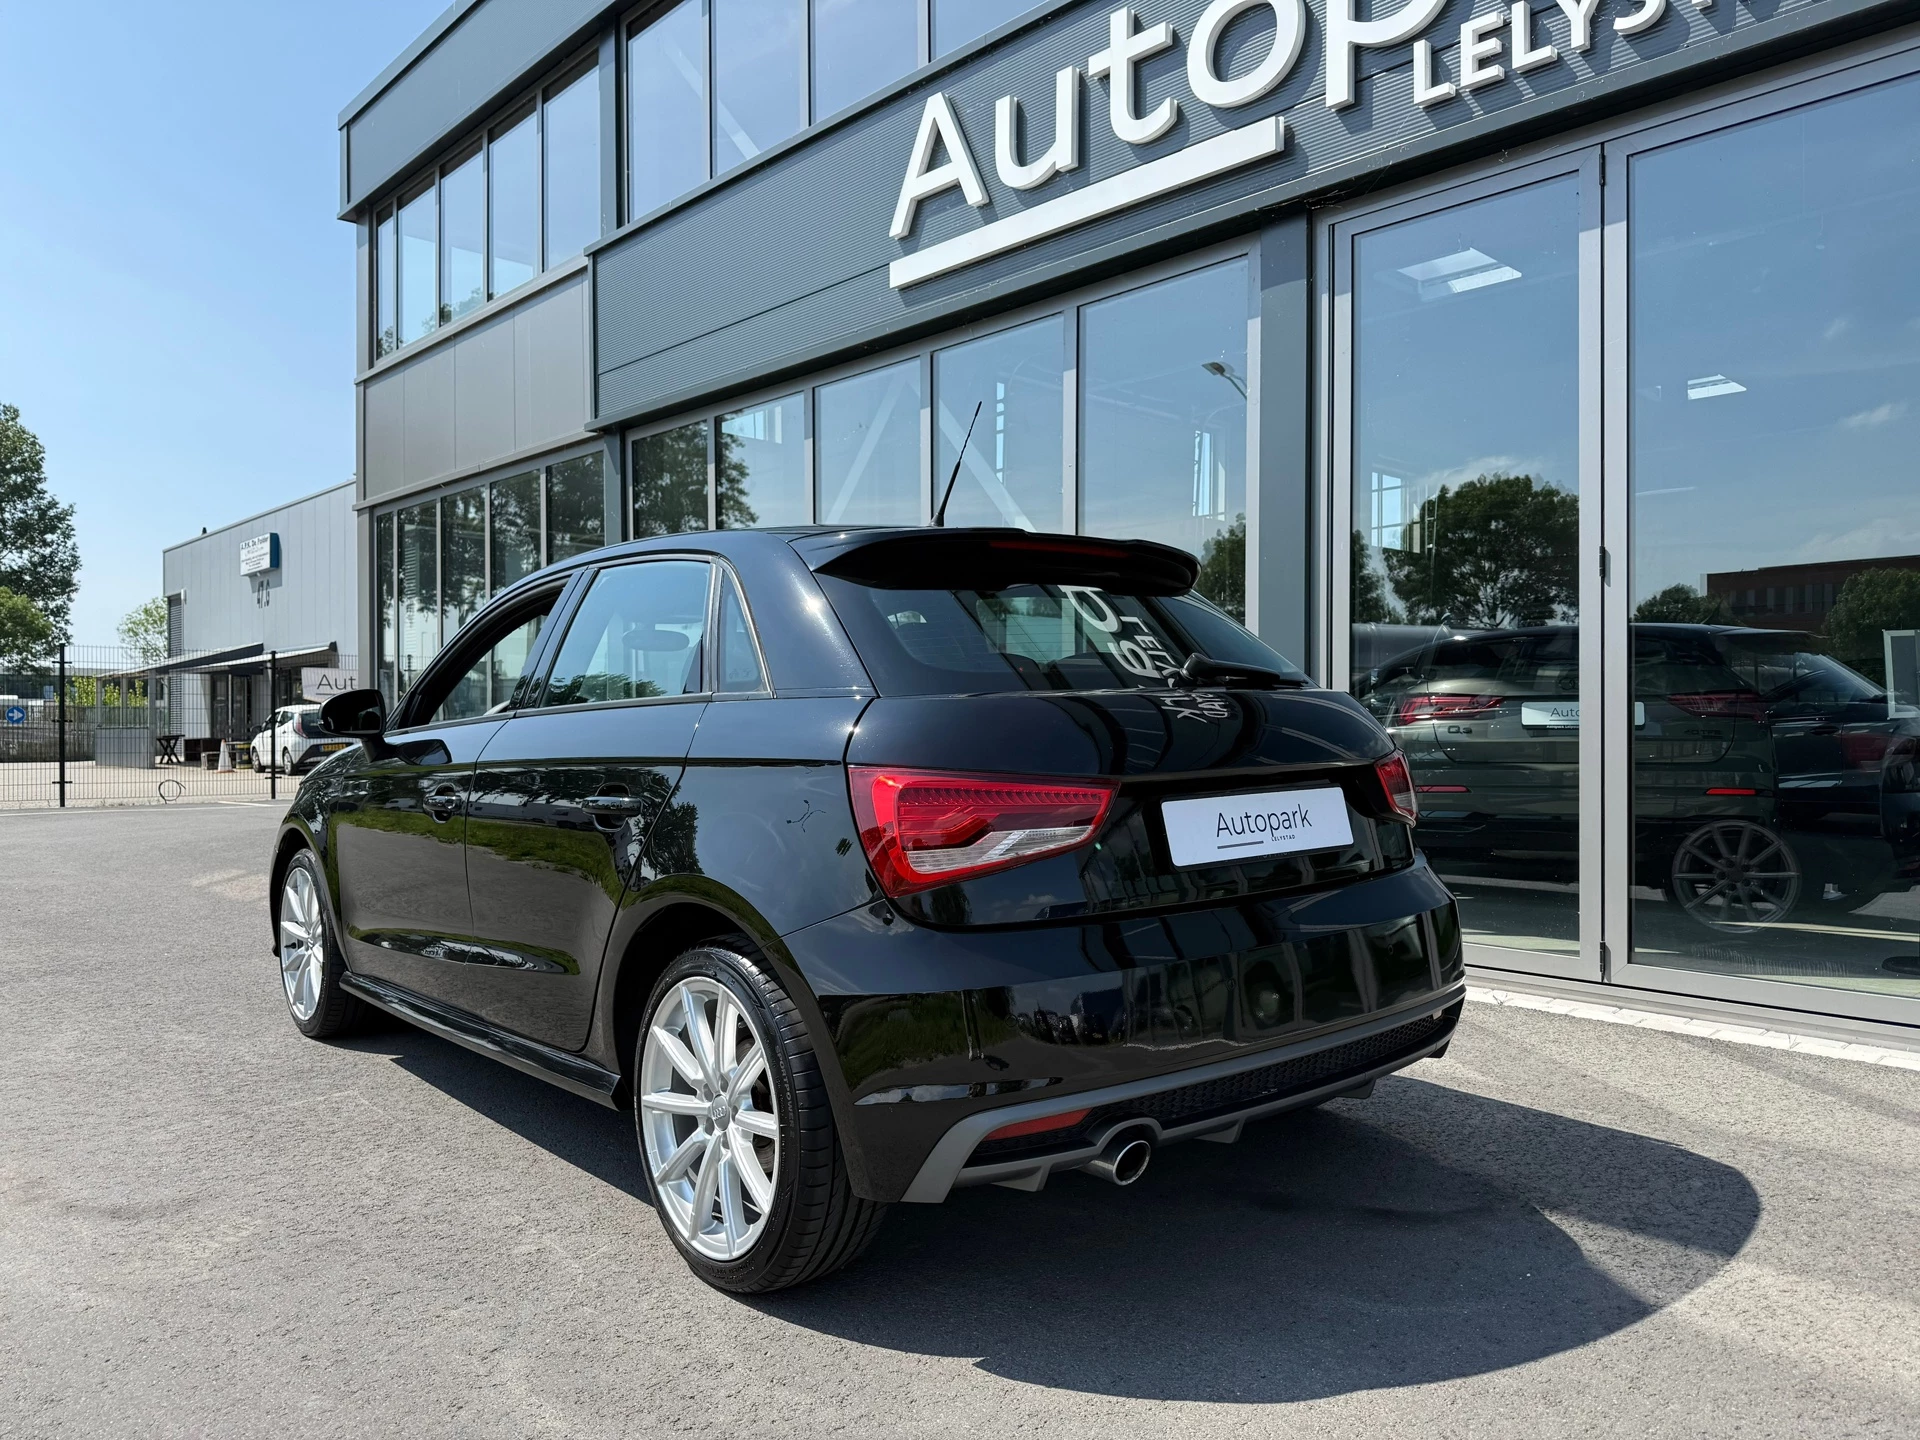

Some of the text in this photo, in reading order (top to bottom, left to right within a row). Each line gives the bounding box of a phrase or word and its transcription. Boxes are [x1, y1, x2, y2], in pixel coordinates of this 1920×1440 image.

[1413, 0, 1713, 108] LELYS
[1447, 725, 1473, 734] Q3
[1217, 803, 1312, 837] Autopark
[1270, 834, 1296, 842] LELYSTAD
